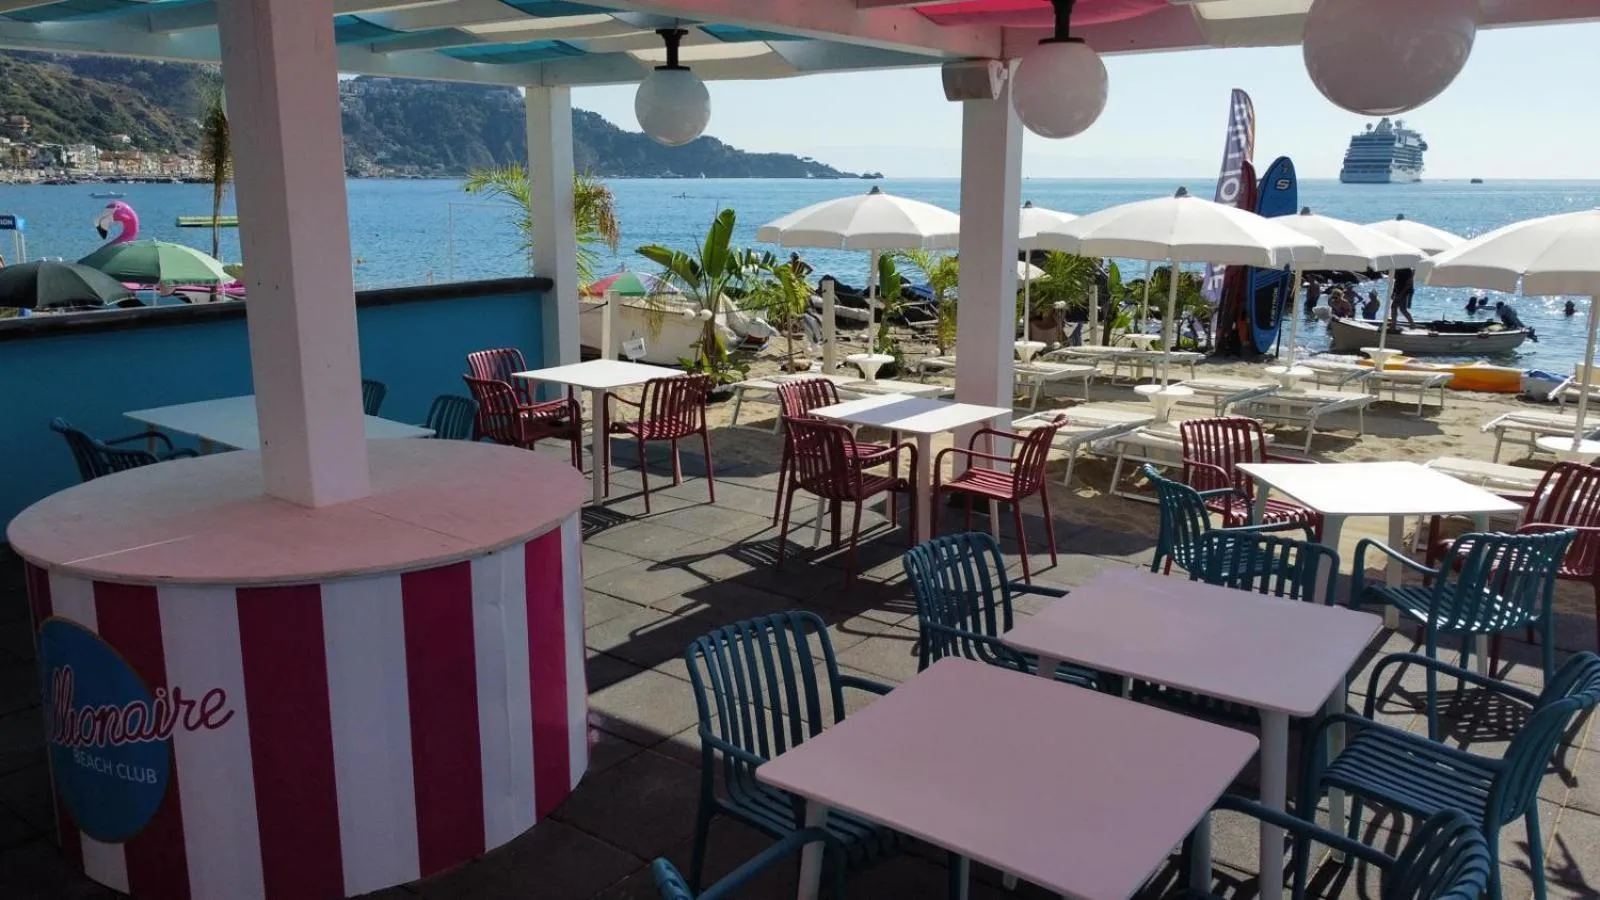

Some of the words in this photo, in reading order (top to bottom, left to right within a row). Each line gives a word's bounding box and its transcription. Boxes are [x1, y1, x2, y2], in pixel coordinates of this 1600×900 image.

[1275, 178, 1290, 190] S
[48, 664, 235, 747] llionaire
[72, 749, 113, 776] BEACH
[116, 762, 158, 784] CLUB
